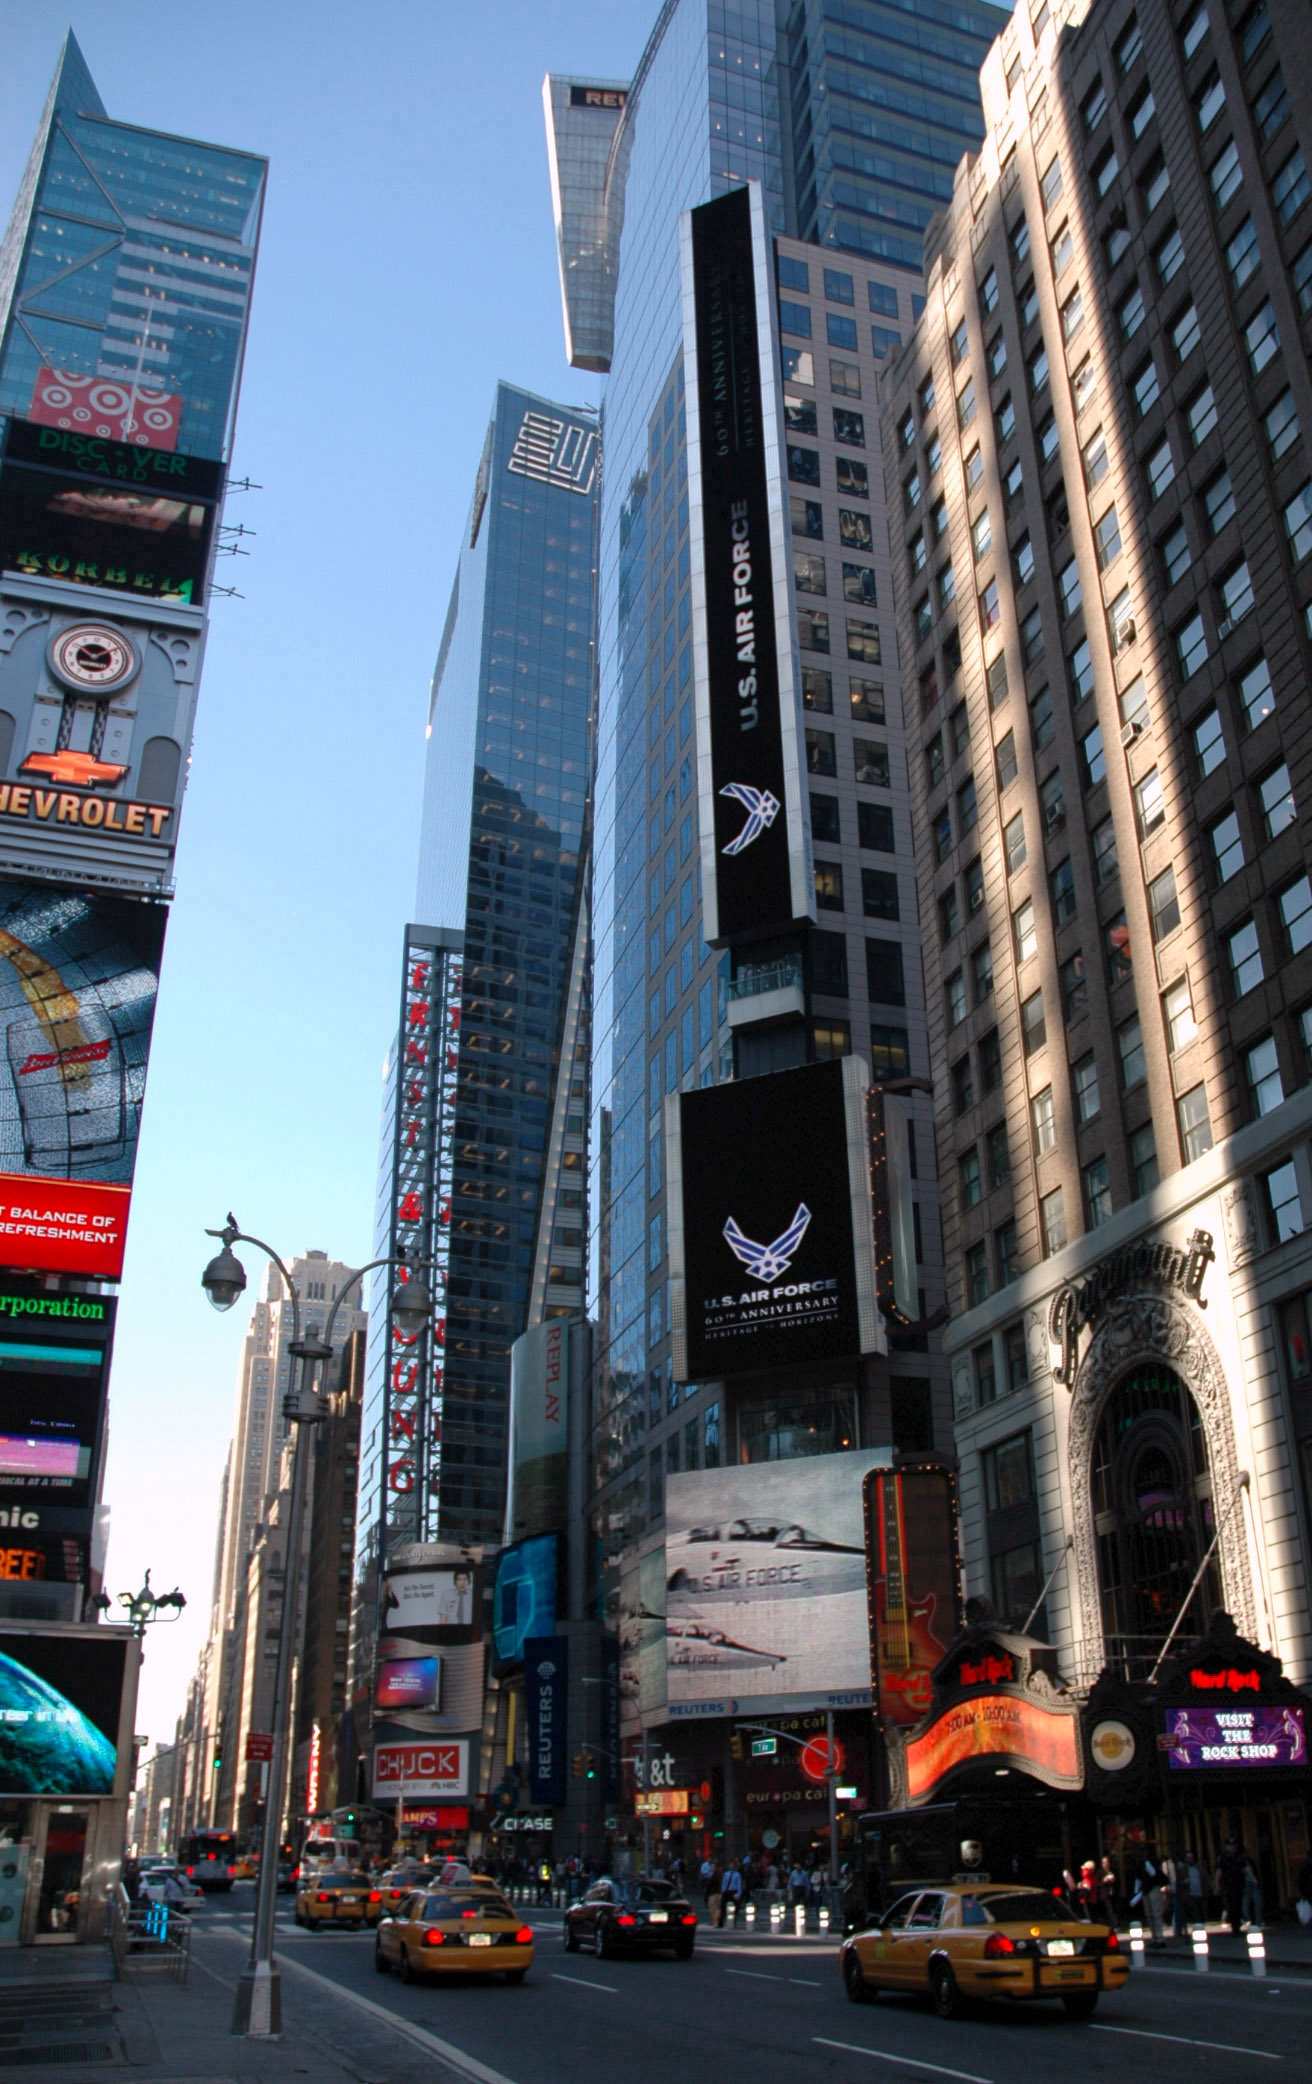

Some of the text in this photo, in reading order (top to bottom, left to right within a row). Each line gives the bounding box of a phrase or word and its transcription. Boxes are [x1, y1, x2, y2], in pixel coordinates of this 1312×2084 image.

[76, 456, 148, 481] CARD
[16, 551, 180, 594] KORBEL
[730, 498, 759, 732] U.S. AIR FORCE
[406, 962, 429, 1147] ERNST
[10, 1206, 87, 1225] BALANCE
[92, 1216, 116, 1227] OF
[398, 1192, 424, 1222] &
[705, 1278, 838, 1310] U.S. AIR FORCE
[739, 1296, 839, 1320] ANNIVERSARY
[545, 1326, 561, 1424] REPLAY
[746, 1564, 803, 1587] FORCE
[669, 1702, 724, 1717] REUTERS
[1215, 1713, 1254, 1729] VISIT
[538, 1685, 553, 1780] REUTERS
[1221, 1730, 1253, 1744] THE
[378, 1751, 455, 1777] CHUCK
[1201, 1744, 1278, 1761] ROCK SHOP
